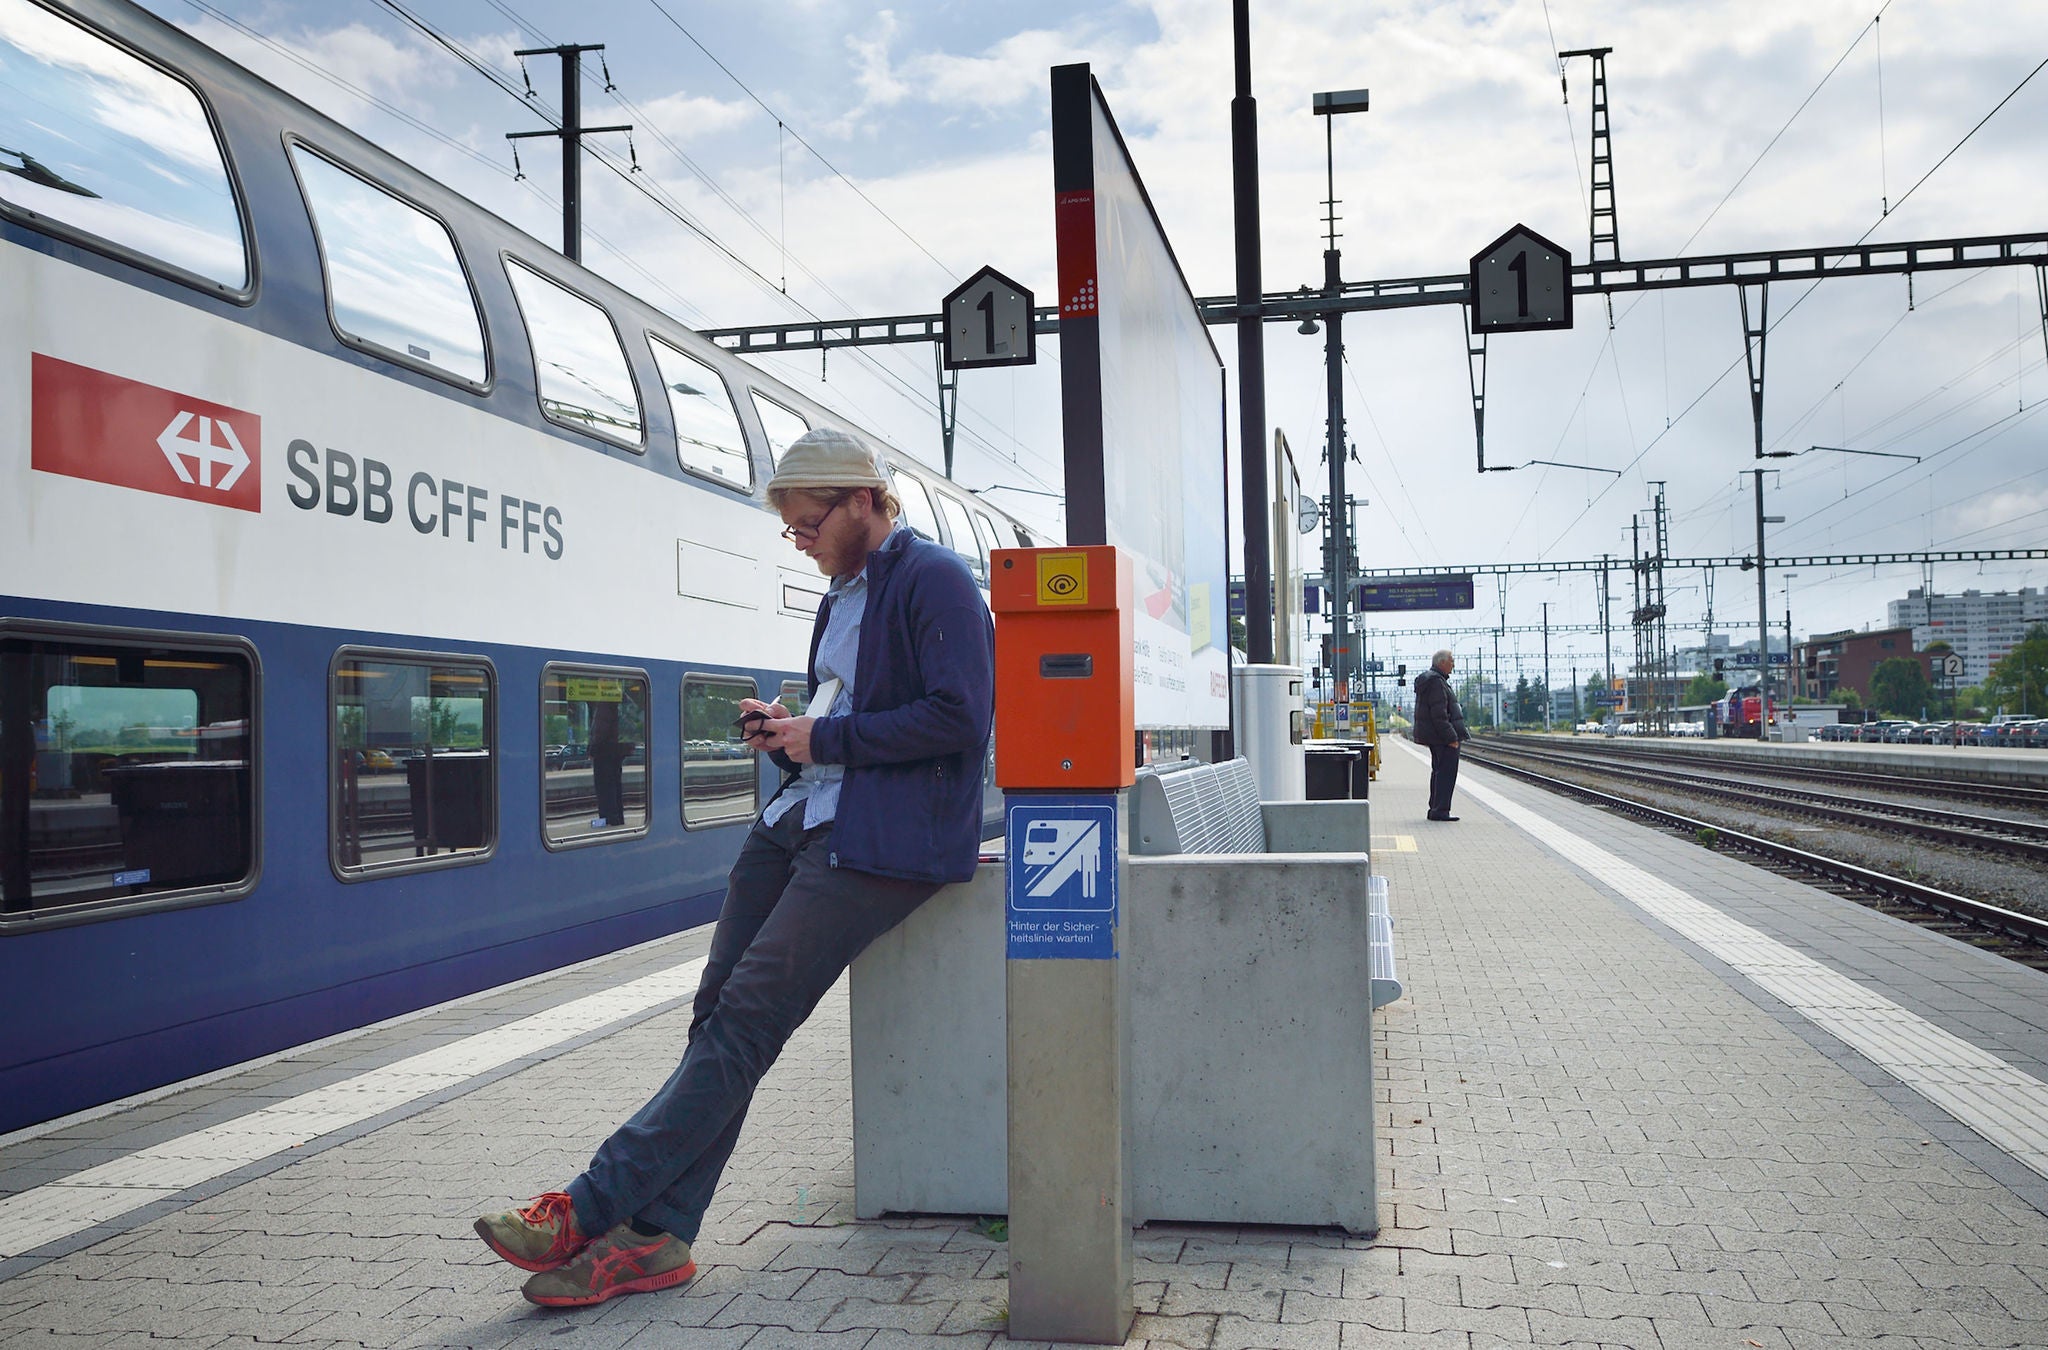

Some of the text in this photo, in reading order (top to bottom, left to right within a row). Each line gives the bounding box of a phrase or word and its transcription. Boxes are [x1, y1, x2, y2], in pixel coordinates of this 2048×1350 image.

[1508, 250, 1528, 317] 1
[976, 291, 995, 354] 1
[286, 438, 564, 561] SBB CFF FFS
[1949, 659, 1959, 673] 2
[1356, 683, 1362, 692] 2
[1010, 921, 1100, 932] Hinter der Sicher-
[1010, 933, 1093, 943] heitslinie warten!
